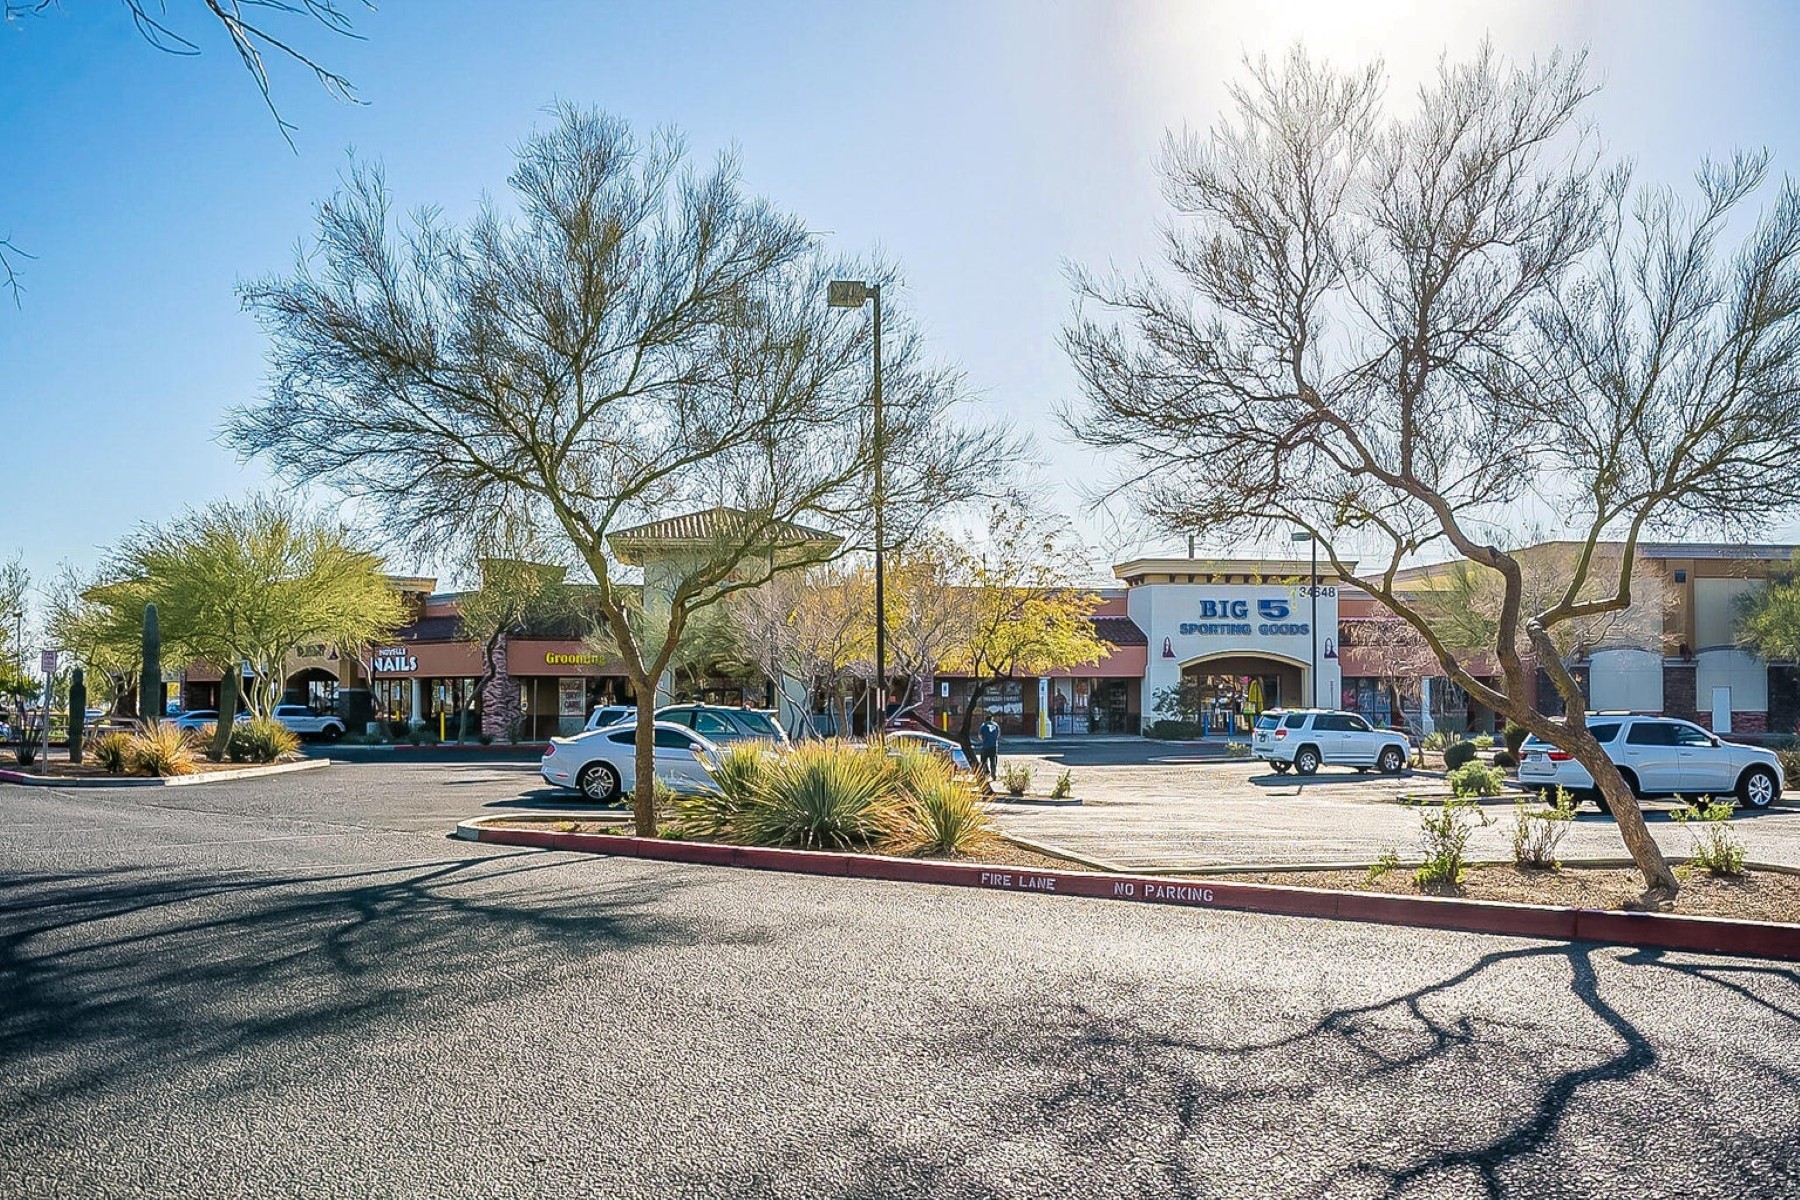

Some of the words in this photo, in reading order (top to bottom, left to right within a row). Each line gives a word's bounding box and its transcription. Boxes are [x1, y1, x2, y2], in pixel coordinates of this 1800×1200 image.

[1299, 586, 1336, 598] 34648
[1199, 600, 1248, 619] BIG
[1257, 599, 1290, 621] 5
[1179, 623, 1252, 636] SPORTING
[1258, 623, 1310, 636] GOODS
[370, 656, 418, 672] NAILS
[981, 872, 1012, 886] FIRE
[1019, 876, 1056, 891] LANE
[1114, 881, 1134, 897] NO
[1145, 884, 1214, 902] PARKING
